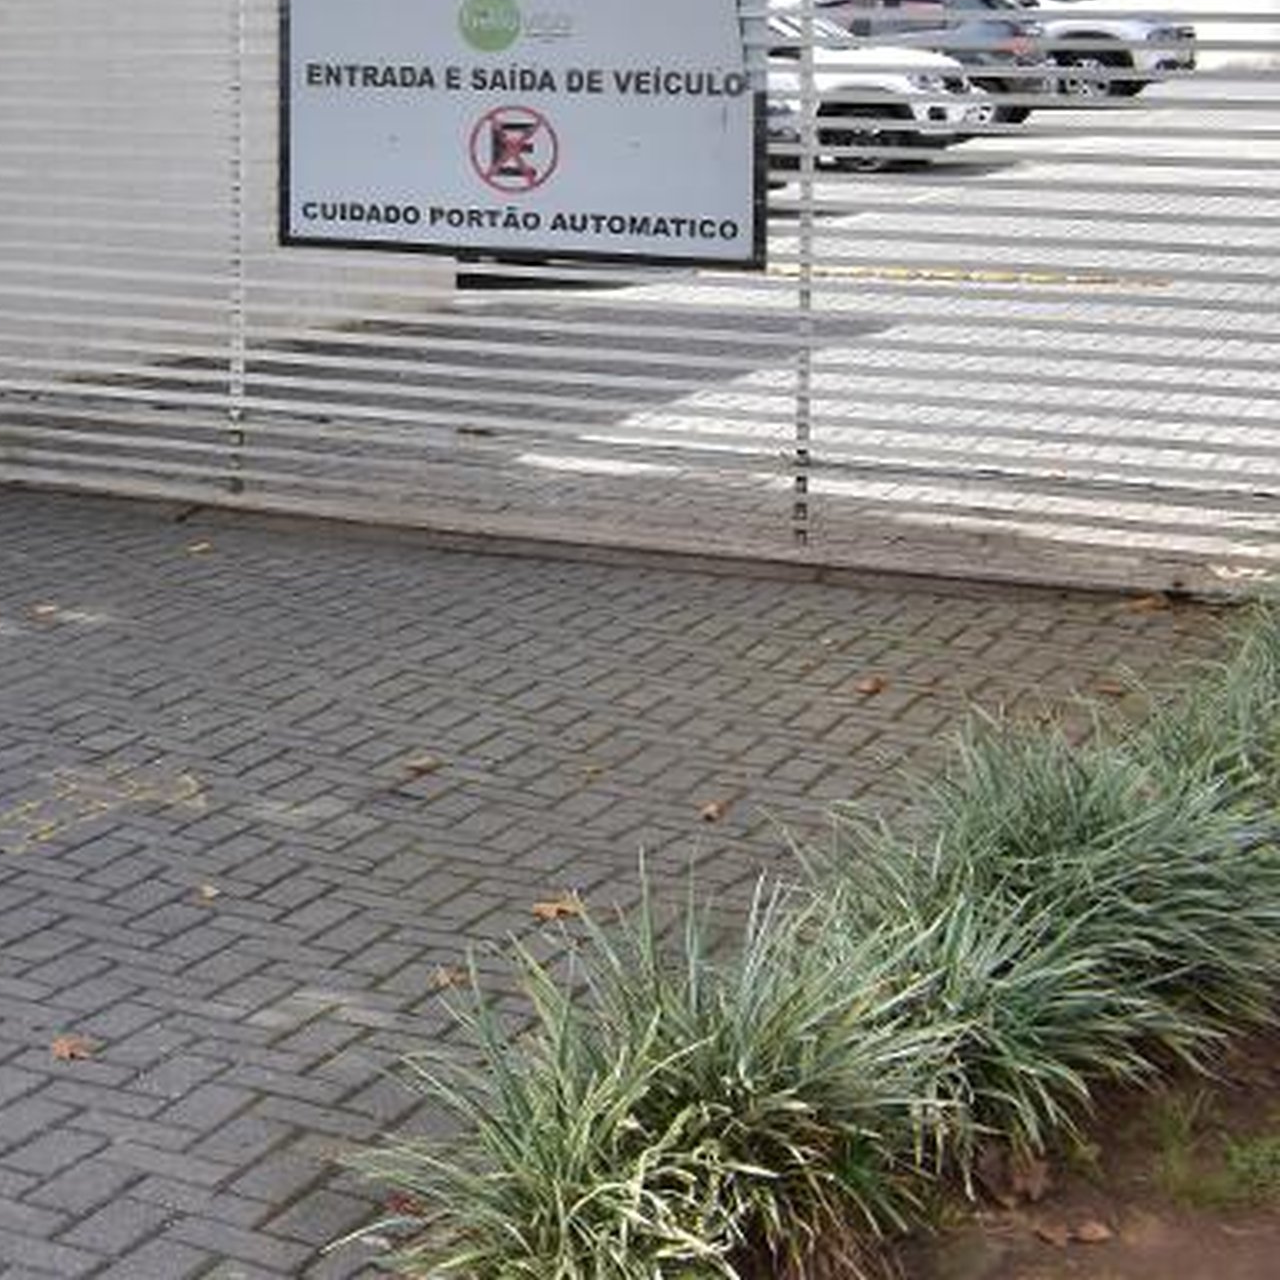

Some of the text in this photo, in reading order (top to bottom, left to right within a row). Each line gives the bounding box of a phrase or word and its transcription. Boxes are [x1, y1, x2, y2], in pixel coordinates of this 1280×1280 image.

[306, 63, 436, 89] ENTRADA
[445, 67, 462, 91] E
[471, 63, 557, 93] SAÍDA
[566, 70, 604, 94] DE
[301, 201, 739, 241] CUIDADO PORTÃO AUTOMATICO
